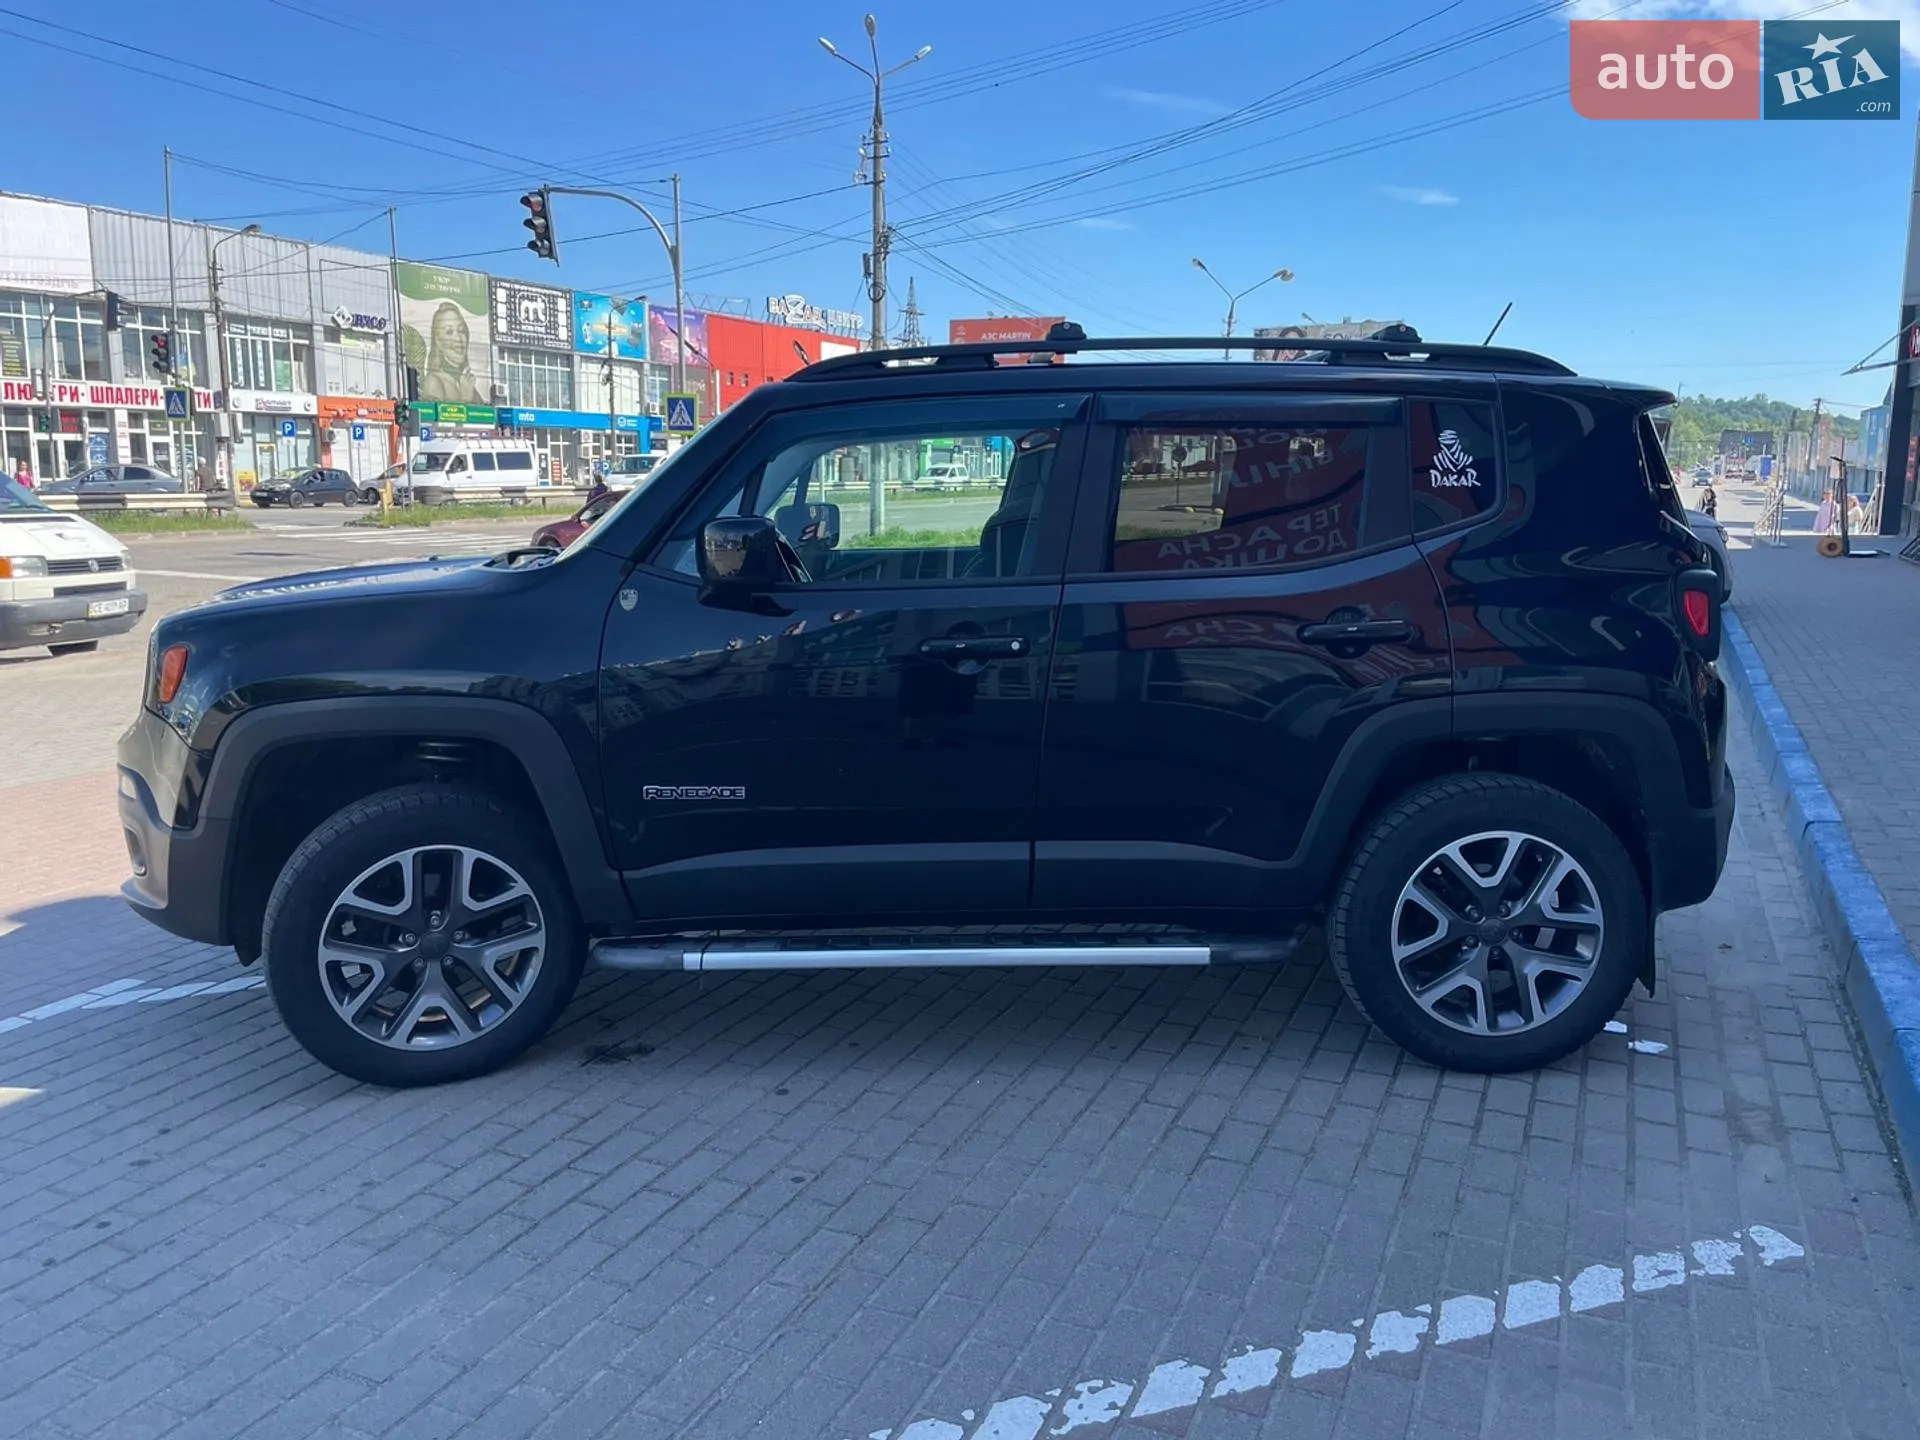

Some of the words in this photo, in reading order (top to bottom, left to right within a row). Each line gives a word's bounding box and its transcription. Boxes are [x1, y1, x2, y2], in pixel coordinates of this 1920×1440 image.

[998, 332, 1031, 341] MARTIN
[4, 382, 80, 403] ЛЮРИ
[90, 385, 159, 407] ШПАЛЕРИ
[1430, 468, 1482, 488] DAKAR
[642, 785, 746, 800] RENEGADE
